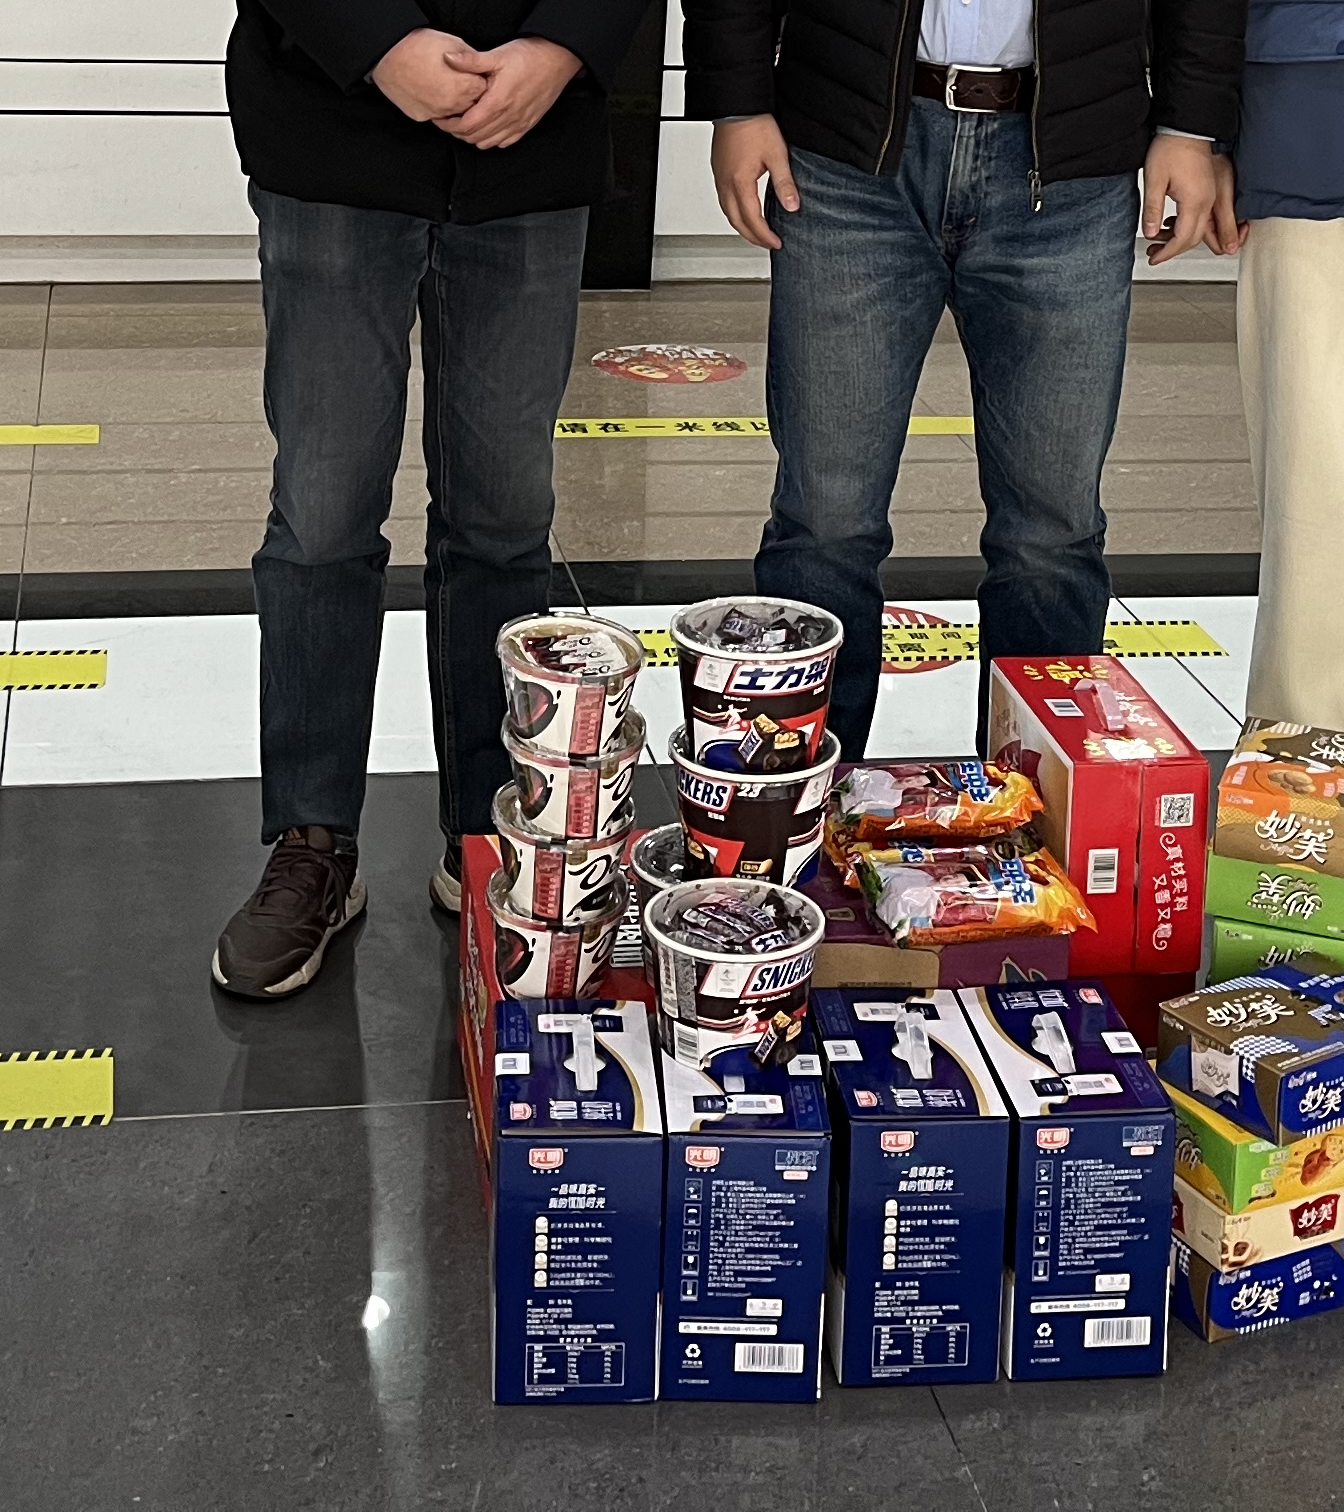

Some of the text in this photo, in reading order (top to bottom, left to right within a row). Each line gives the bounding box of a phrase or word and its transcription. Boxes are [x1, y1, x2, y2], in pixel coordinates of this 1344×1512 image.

[733, 658, 829, 691] 士力架
[1255, 809, 1335, 864] 妙芙
[1207, 994, 1294, 1028] 妙芙
[883, 1133, 912, 1147] 光明
[1039, 1130, 1067, 1144] 光明
[531, 1150, 562, 1164] 光明
[688, 1148, 718, 1162] 光明
[1298, 1205, 1334, 1230] 妙芙
[1231, 1282, 1283, 1317] 妙芙
